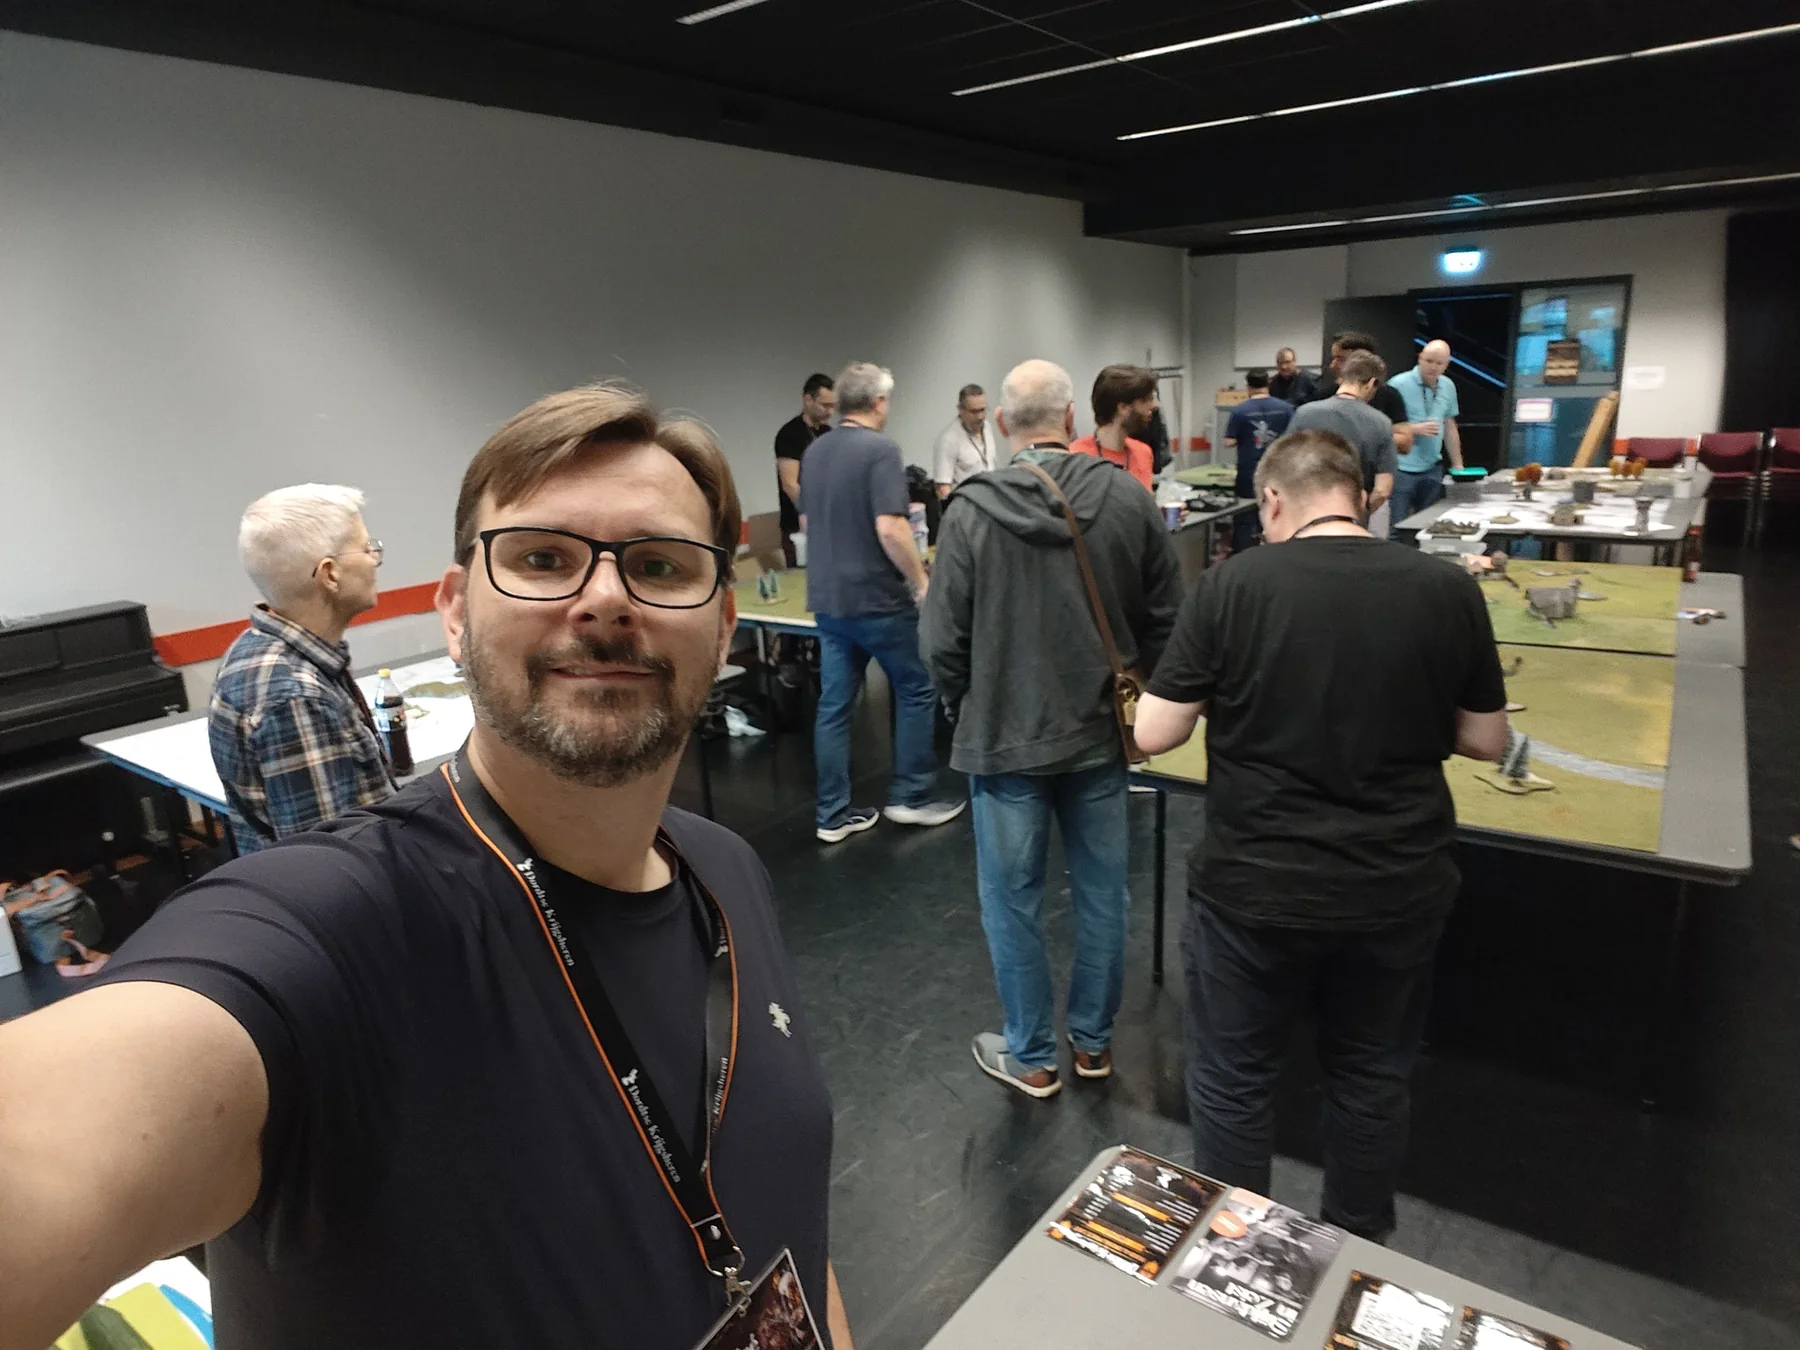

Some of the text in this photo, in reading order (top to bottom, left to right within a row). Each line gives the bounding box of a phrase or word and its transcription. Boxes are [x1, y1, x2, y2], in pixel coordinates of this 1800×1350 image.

[523, 870, 575, 967] Dordtse Krijgsheren
[628, 1084, 681, 1183] Dordtse Krijgsheren
